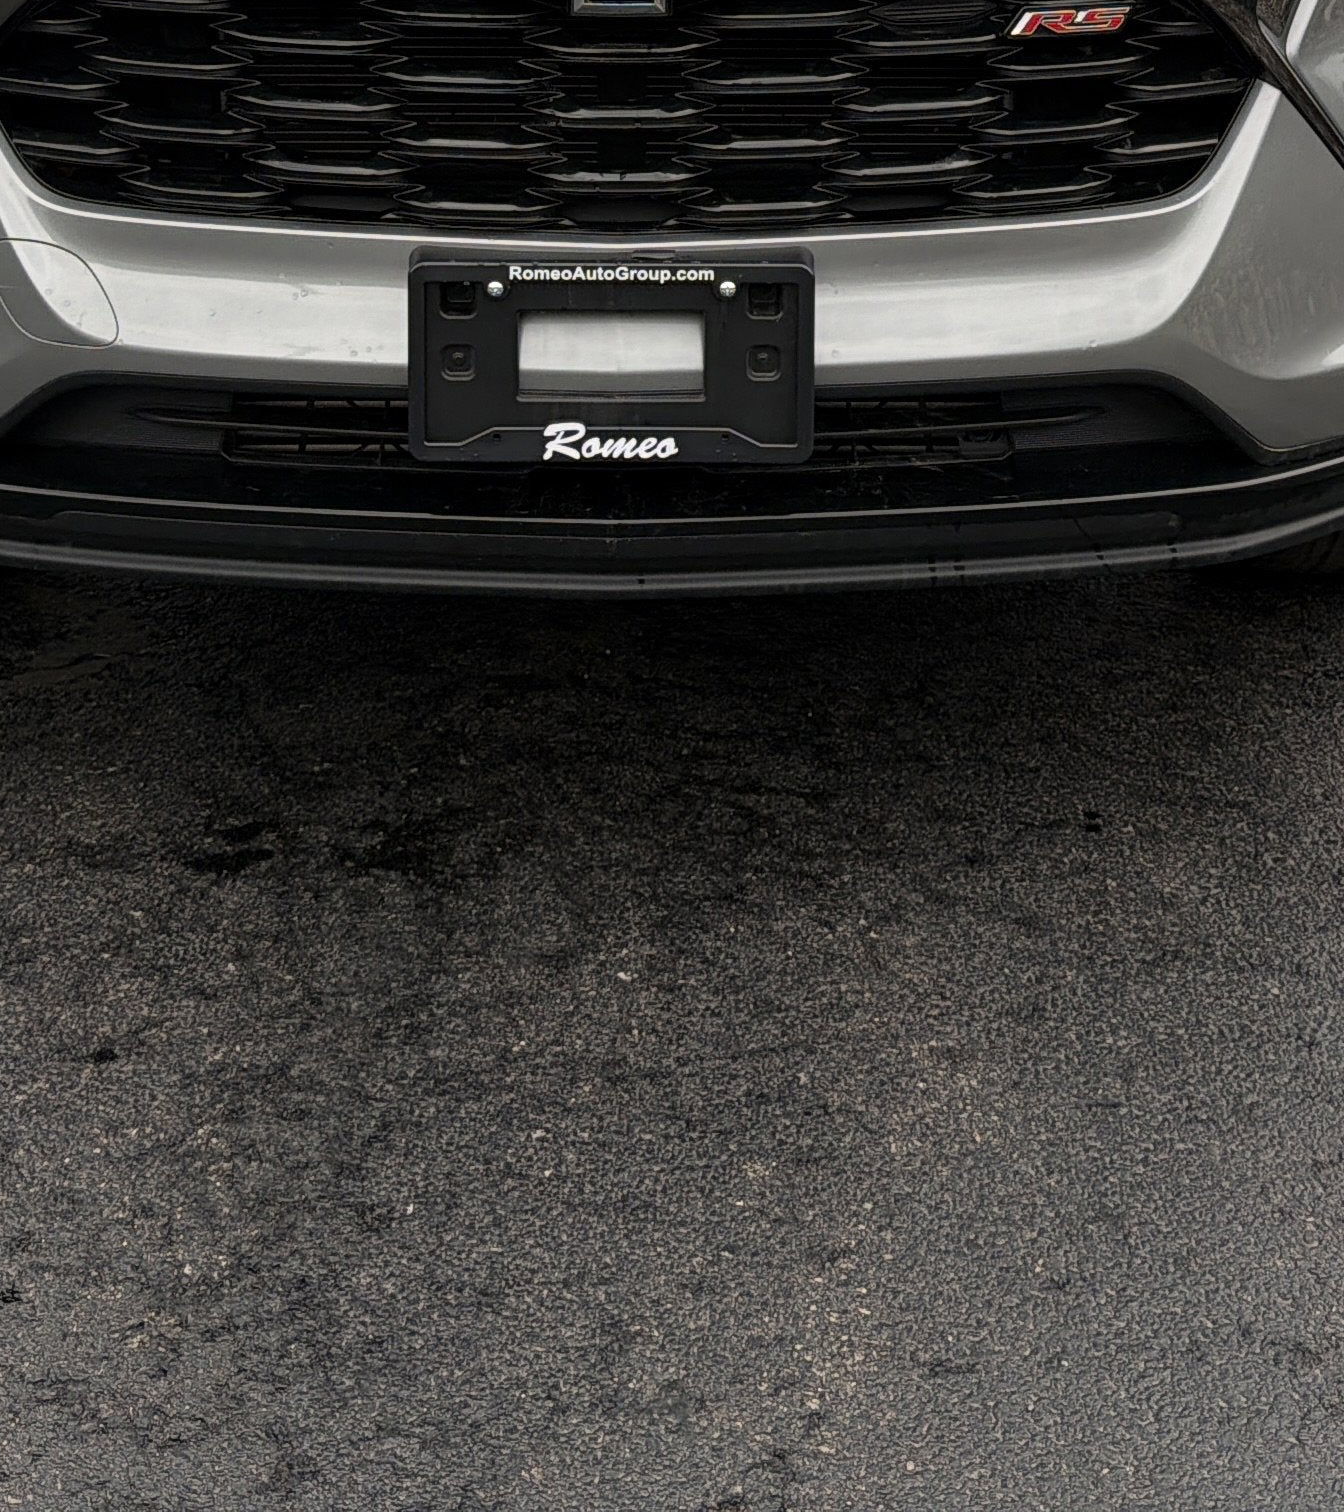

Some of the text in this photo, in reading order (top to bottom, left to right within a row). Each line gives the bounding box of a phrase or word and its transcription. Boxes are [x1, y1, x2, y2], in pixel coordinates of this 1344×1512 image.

[1010, 6, 1130, 35] RS
[509, 265, 715, 284] RomeoAutoGroup.com
[542, 422, 679, 461] Romeo
